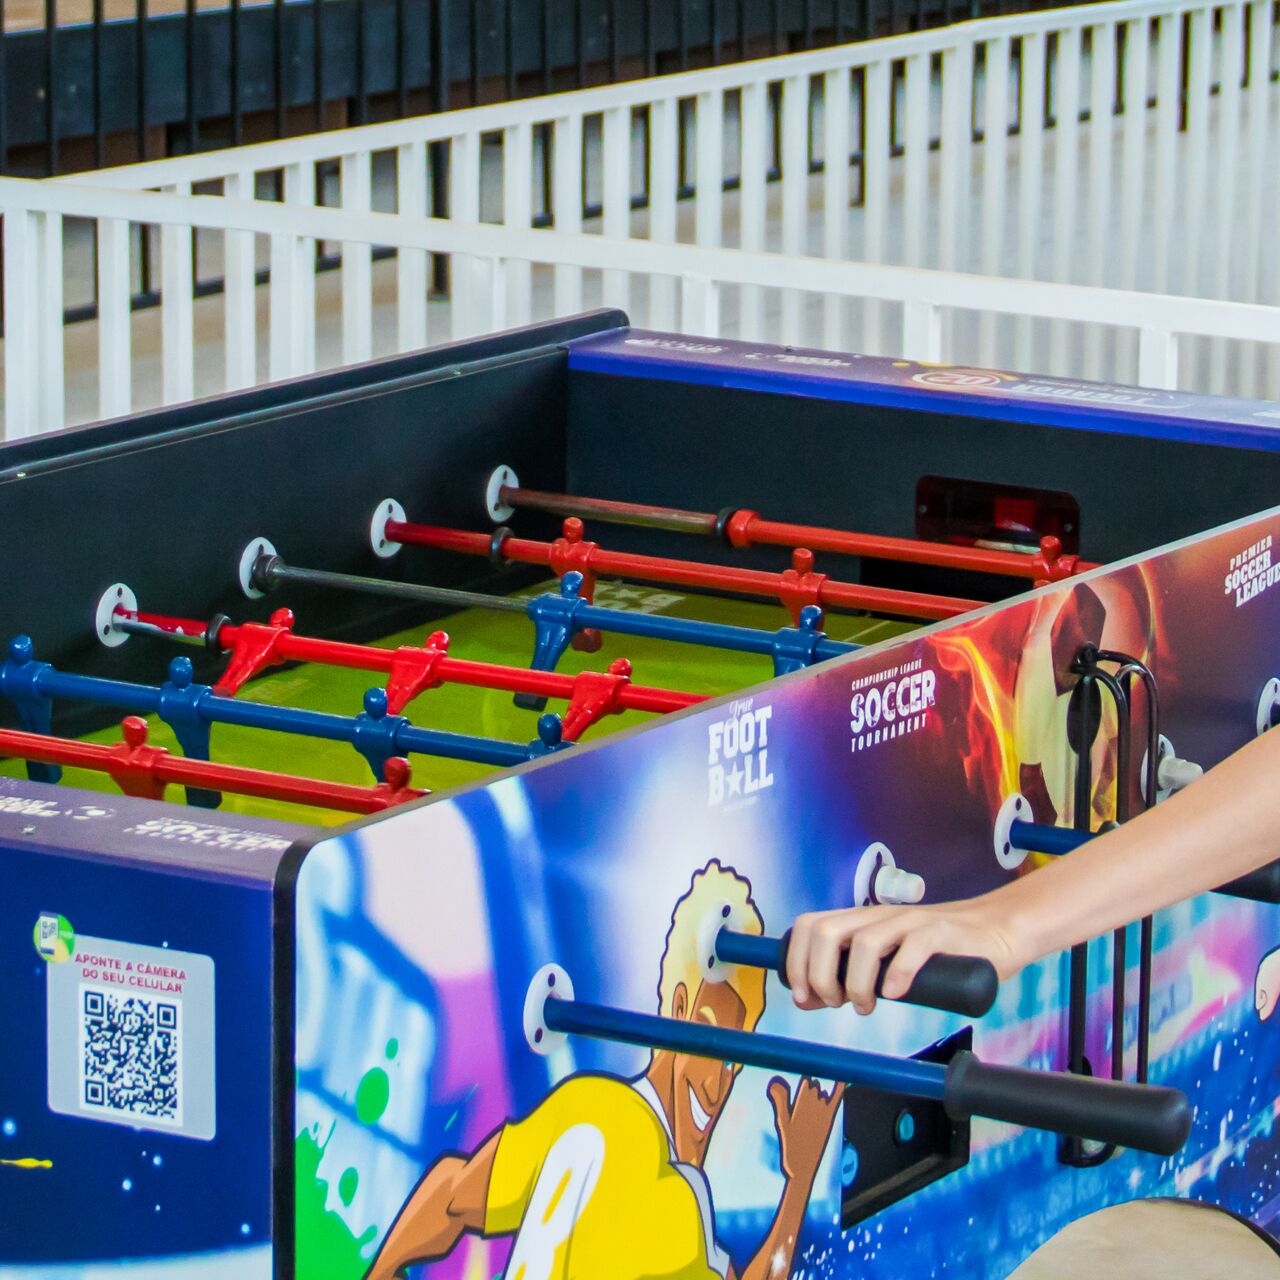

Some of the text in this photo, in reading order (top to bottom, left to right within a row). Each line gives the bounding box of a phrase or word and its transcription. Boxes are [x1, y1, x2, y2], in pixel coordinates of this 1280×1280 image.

[1224, 549, 1272, 595] SOCCER
[1229, 535, 1273, 571] PREMIER
[851, 658, 923, 691] CHAMPIONSHIP LEAGUE
[850, 669, 936, 734] SOCCER
[708, 705, 773, 766] FOOT
[851, 713, 927, 753] TOURNAMENT
[75, 953, 122, 970] APONTE
[125, 961, 134, 972] A
[82, 967, 183, 993] DO SEU CELULAR
